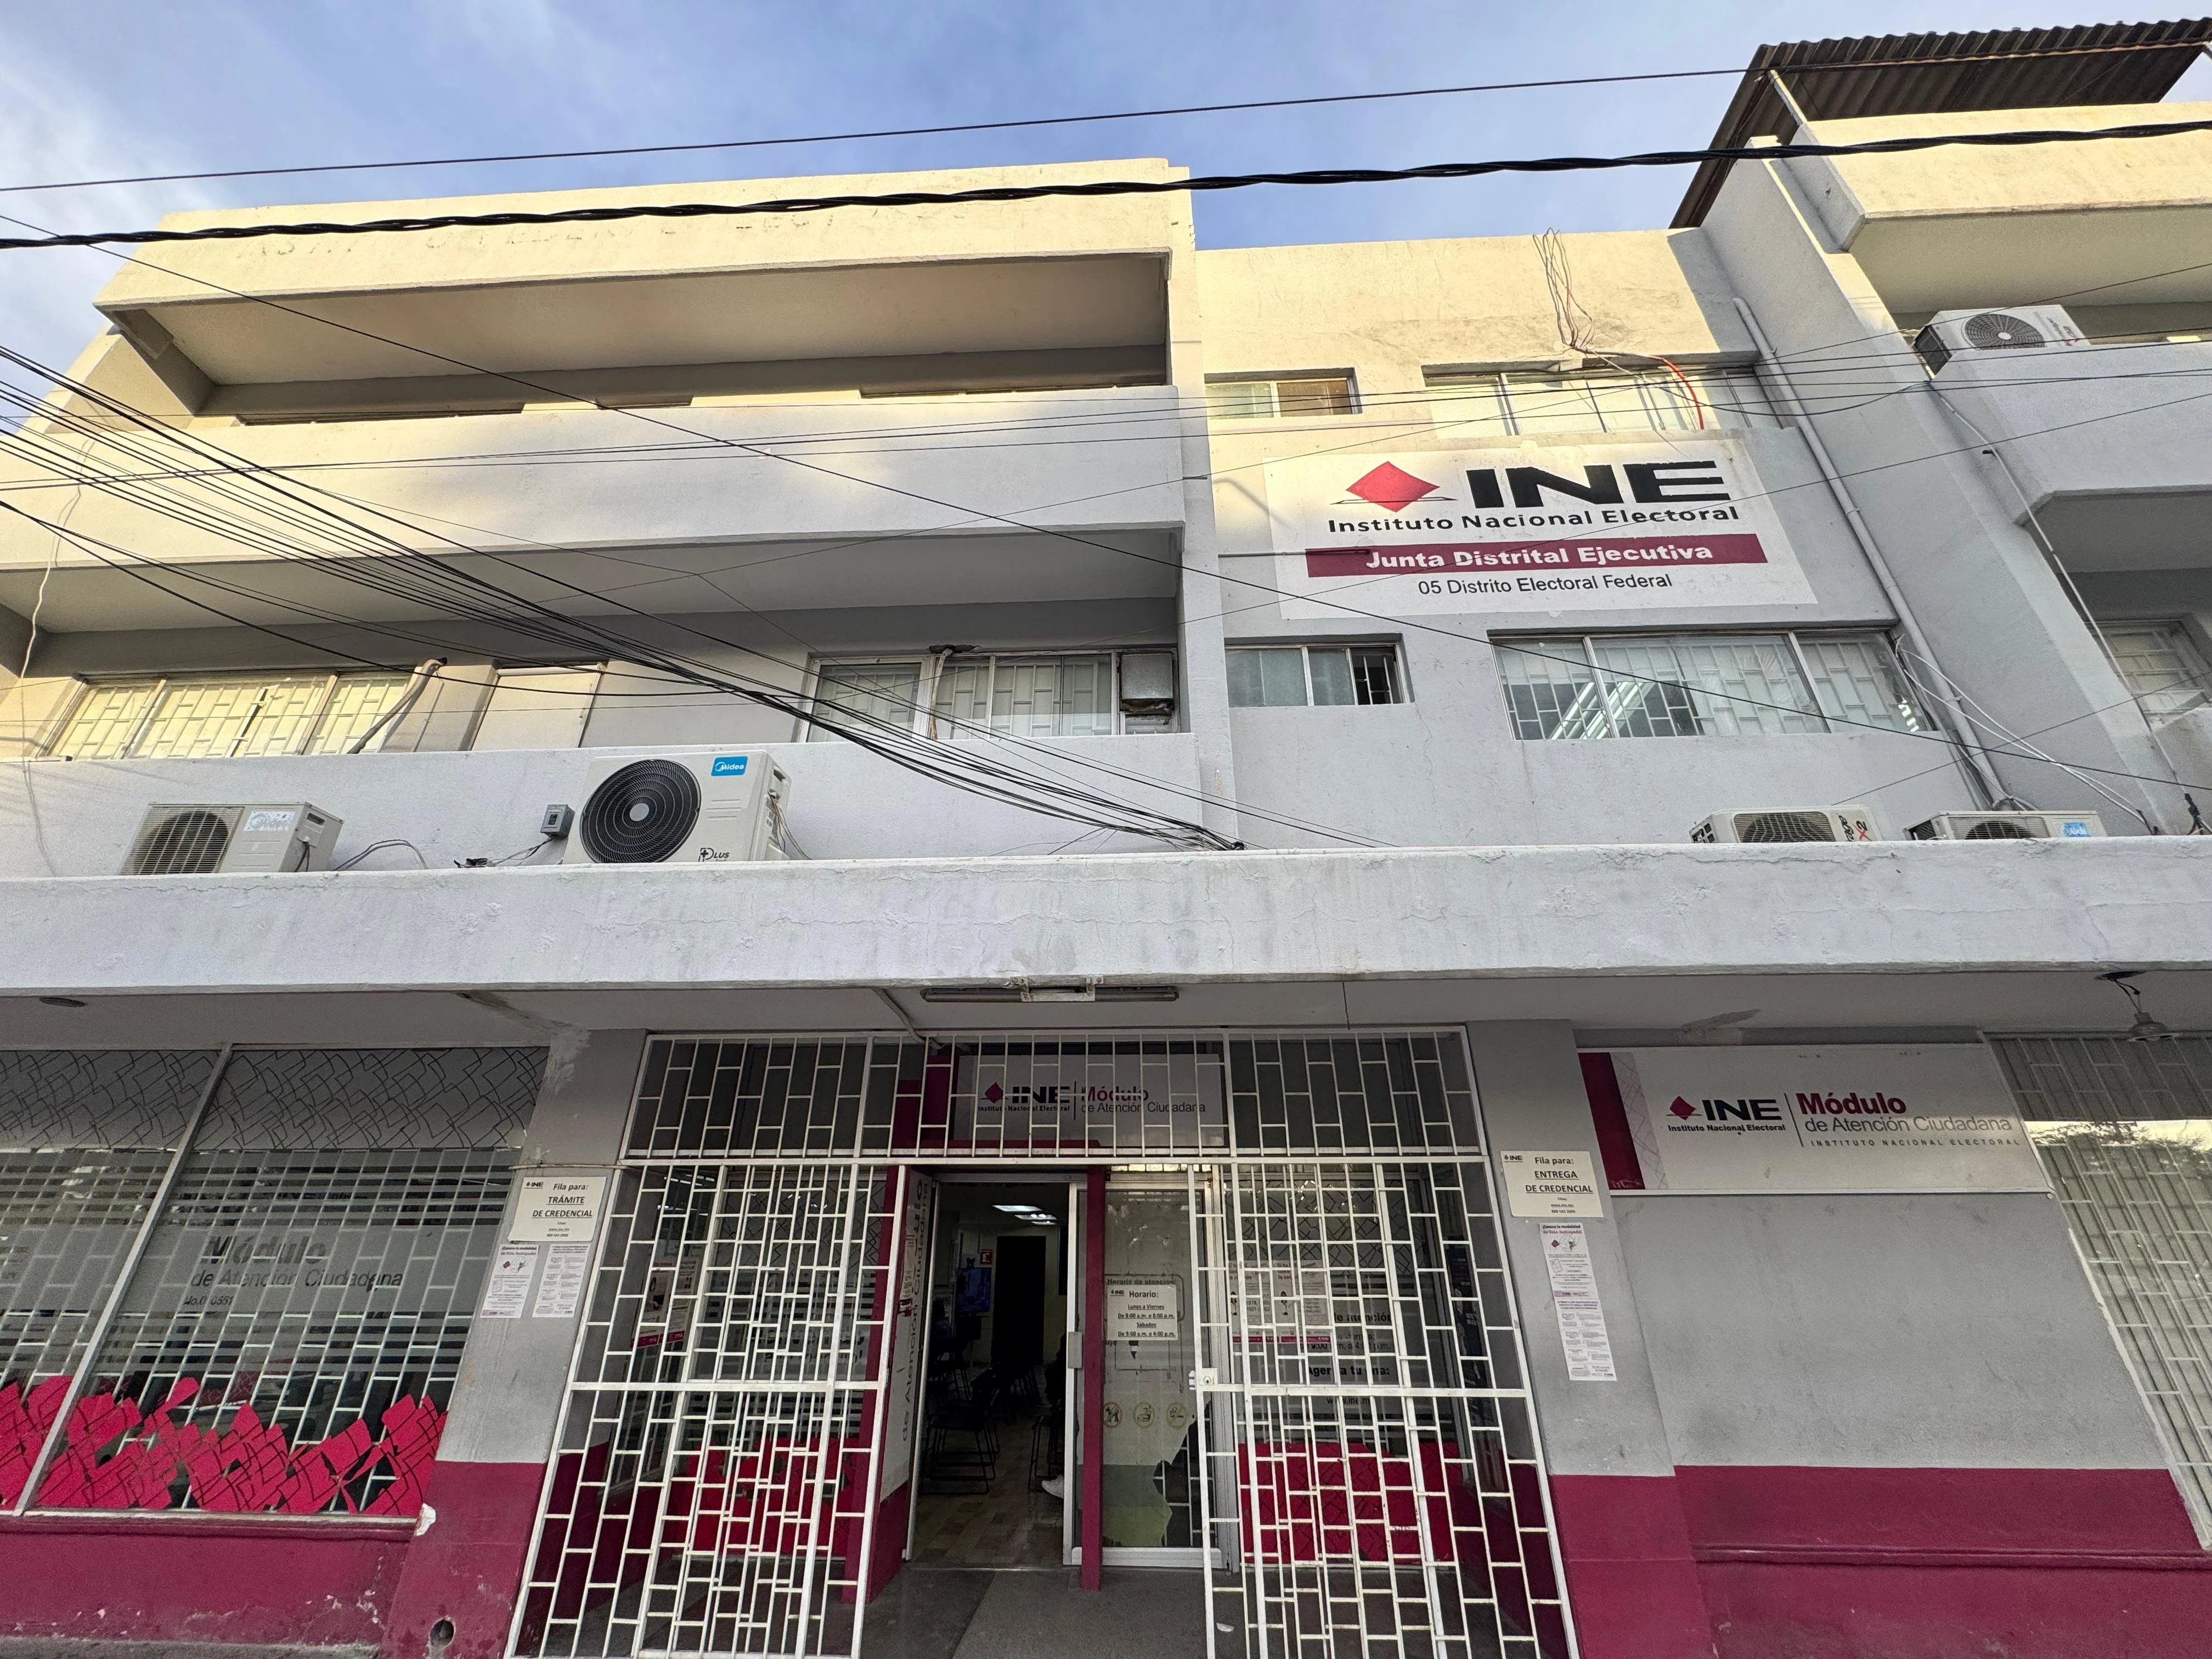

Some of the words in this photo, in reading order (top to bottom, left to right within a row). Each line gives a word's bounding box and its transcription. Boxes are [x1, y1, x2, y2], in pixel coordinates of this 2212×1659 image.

[1466, 460, 1731, 509] INE
[1328, 518, 1453, 533] Instituto
[1462, 511, 1593, 529] Nacional
[1601, 506, 1739, 524] Electoral
[1366, 552, 1446, 569] Junta
[1453, 548, 1570, 566] Distrital
[1577, 544, 1713, 566] Ejecutiva
[1418, 580, 1442, 595] 05
[1447, 578, 1512, 594] Distrito
[1516, 575, 1599, 592] Electoral
[1602, 573, 1673, 589] Federal
[715, 761, 744, 772] Midea
[1012, 1086, 1070, 1104] INE
[1081, 1086, 1149, 1102] Módulo
[1702, 1099, 1782, 1121] INE
[1796, 1092, 1907, 1115] Módulo
[1804, 1117, 1828, 1132] de
[1832, 1116, 1910, 1132] Atención
[1913, 1116, 2013, 1132] Ciudadana
[1534, 1156, 1550, 1165] Fila
[1552, 1158, 1575, 1166] para:
[548, 1194, 585, 1204] TRÁMITE
